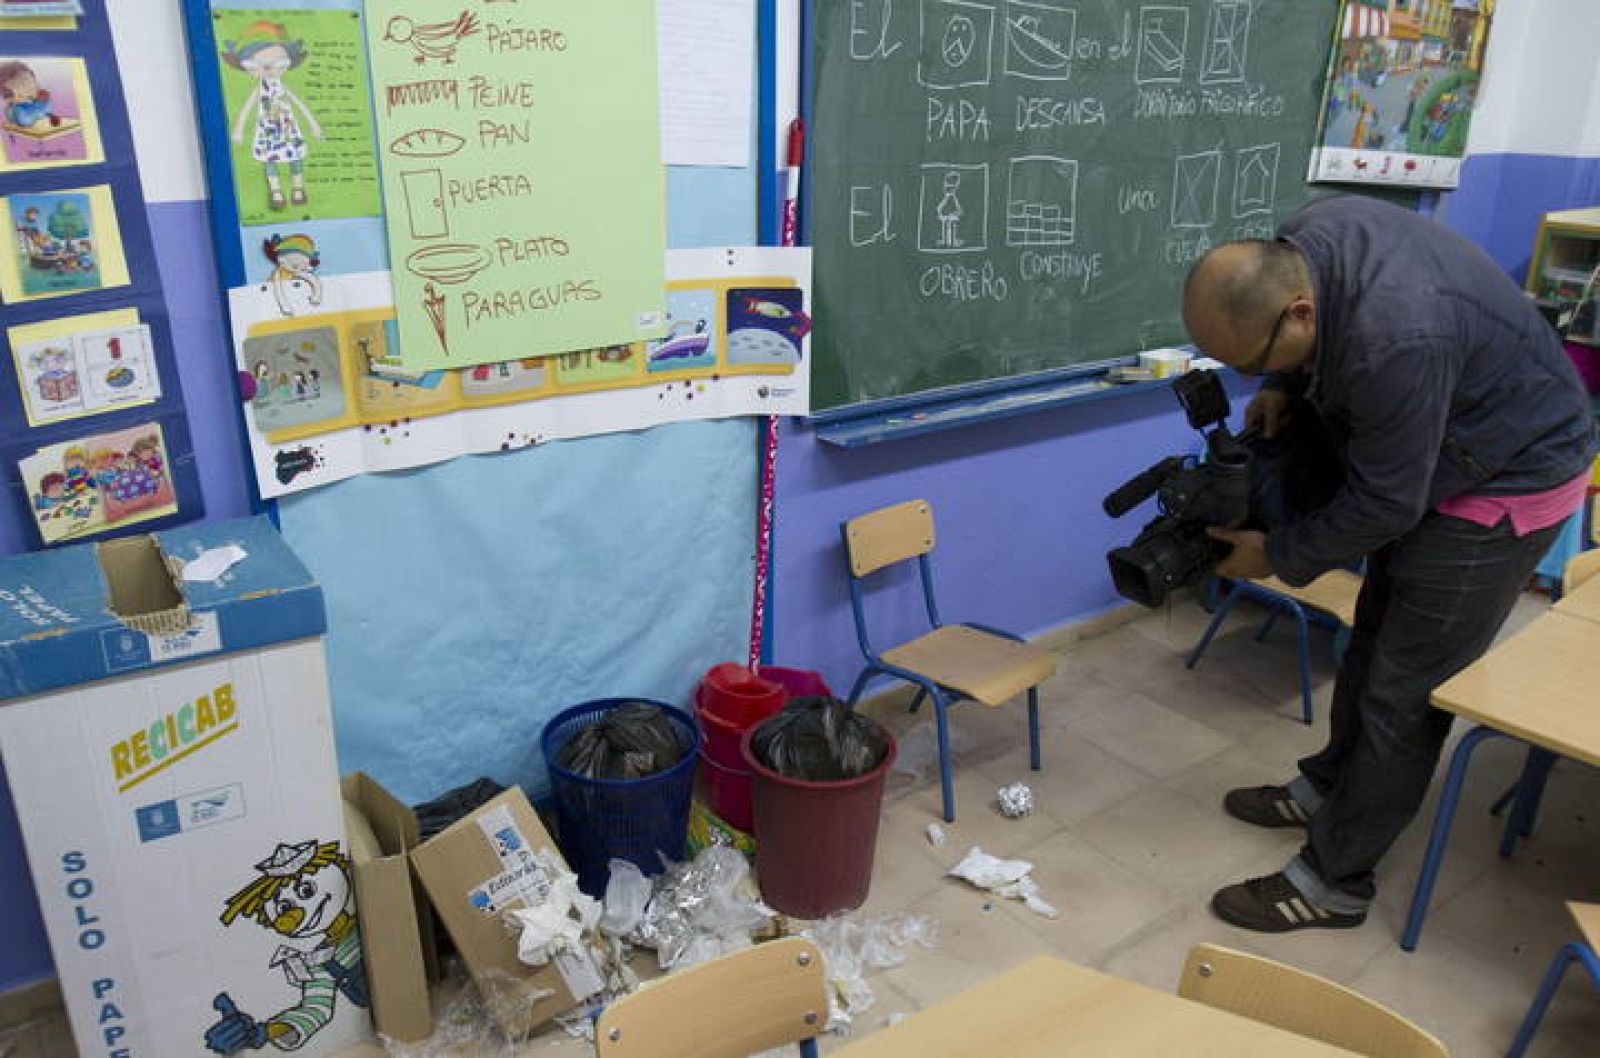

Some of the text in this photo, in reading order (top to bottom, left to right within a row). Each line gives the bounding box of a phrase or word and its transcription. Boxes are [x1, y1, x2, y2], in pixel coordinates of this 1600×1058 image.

[1076, 37, 1101, 59] en
[468, 75, 534, 109] PEINE
[479, 120, 530, 147] PAN
[927, 97, 991, 143] PAPA
[1016, 96, 1105, 132] DESCANSA
[449, 175, 532, 208] PUERTA
[850, 183, 897, 247] El
[495, 237, 570, 267] PLATO
[920, 260, 1008, 301] OBRERO
[461, 280, 602, 329] PARAGUAS
[111, 683, 236, 779] RECICAB
[61, 850, 105, 950] SOLO
